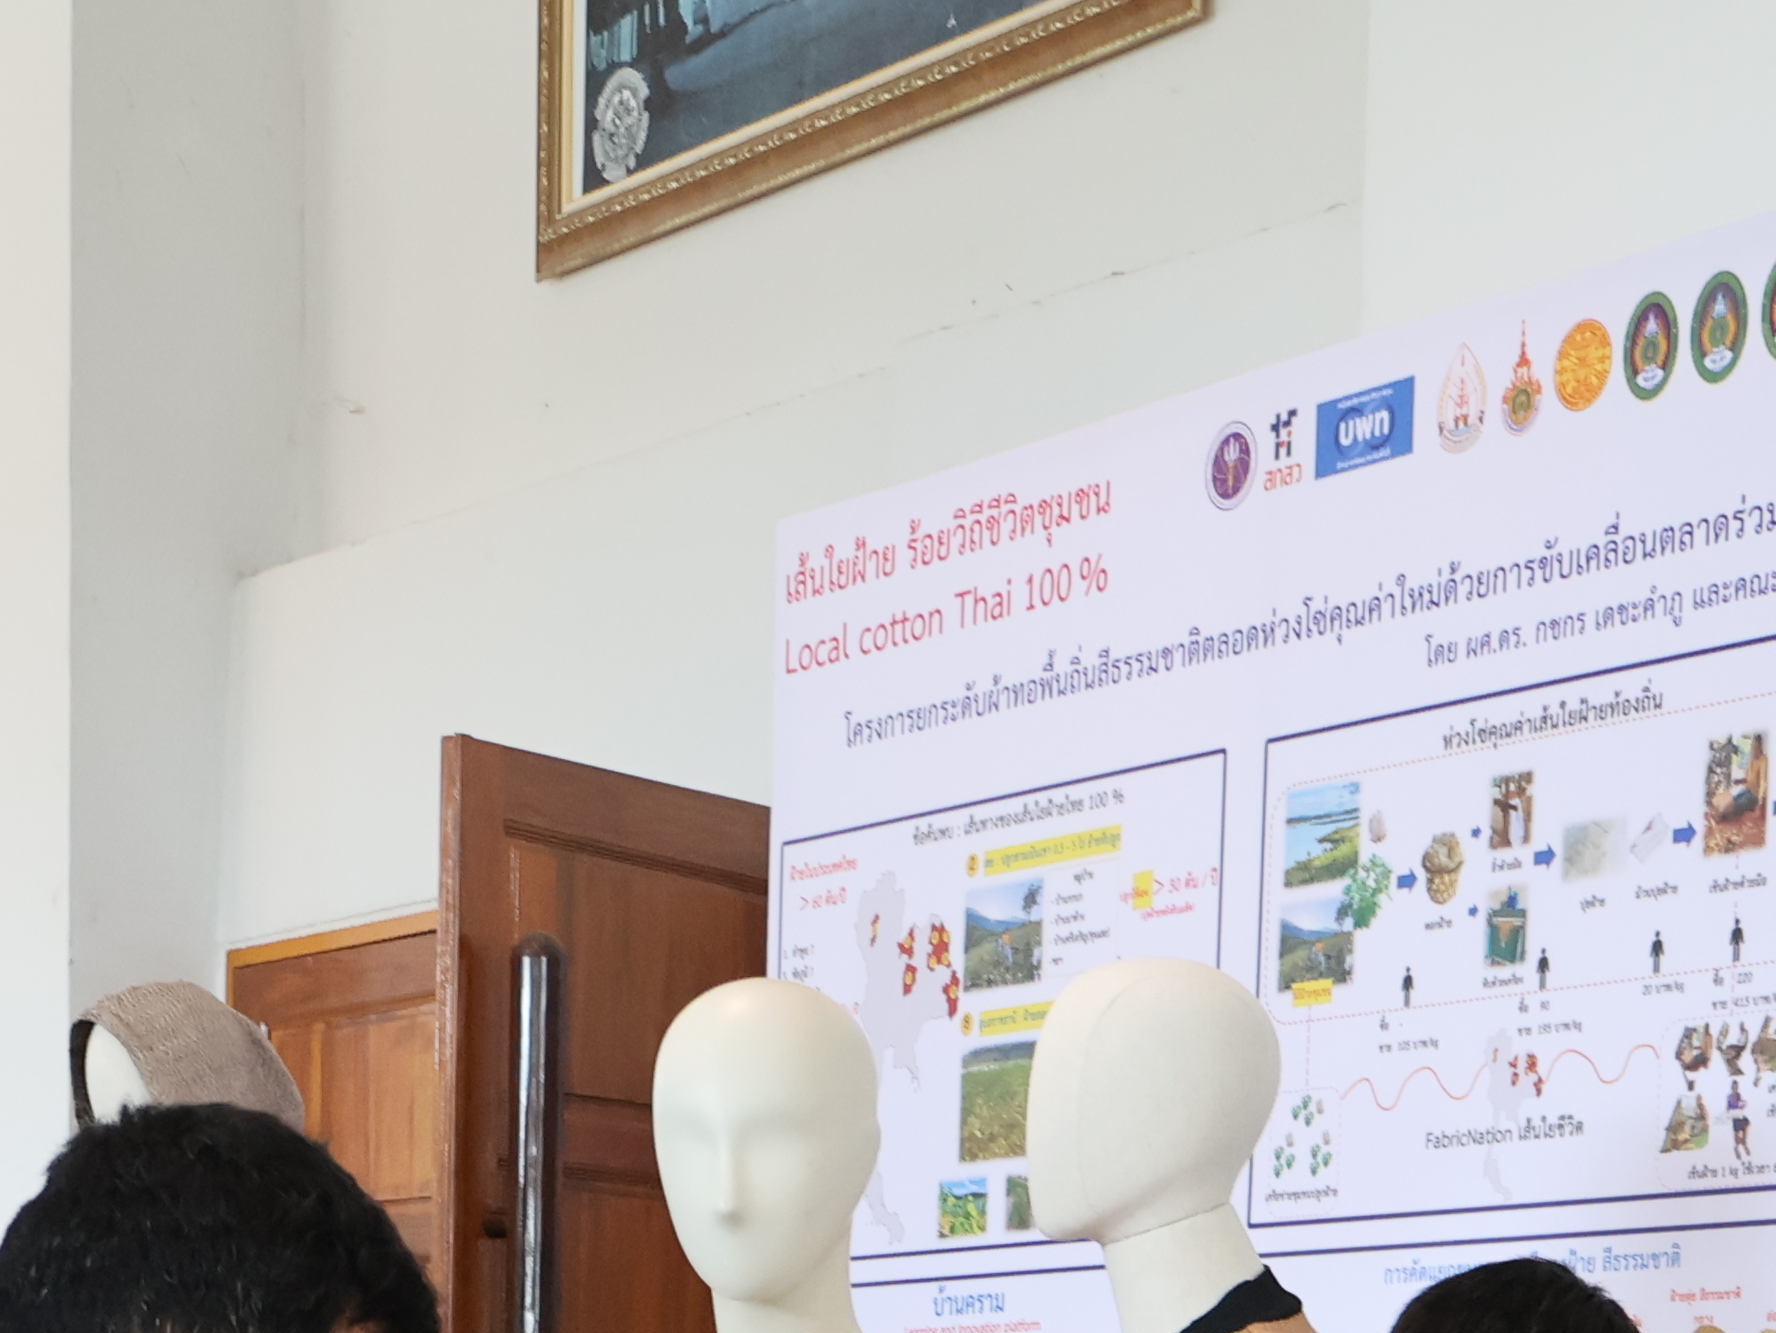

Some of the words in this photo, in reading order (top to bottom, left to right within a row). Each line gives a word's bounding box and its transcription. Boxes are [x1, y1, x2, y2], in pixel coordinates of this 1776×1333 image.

[786, 536, 895, 604] เส้นใยฝ้าย
[907, 480, 1111, 570] ร้อยวิถีชีวิตชุมชน
[785, 622, 850, 675] Local
[859, 609, 944, 656] cotton
[954, 578, 1012, 629] Thai
[1025, 563, 1072, 611] 100
[1079, 553, 1108, 597] %
[1425, 633, 1458, 669] โดย
[1466, 624, 1527, 657] ผศ.ดร.
[1535, 610, 1586, 643] กชกร
[1442, 677, 1664, 752] ห่วงโซ่คุณค่าเส้นใยฝ้ายท้องถิ่น
[1425, 1127, 1513, 1150] FabricNation
[932, 1285, 1005, 1317] บ้านคราม
